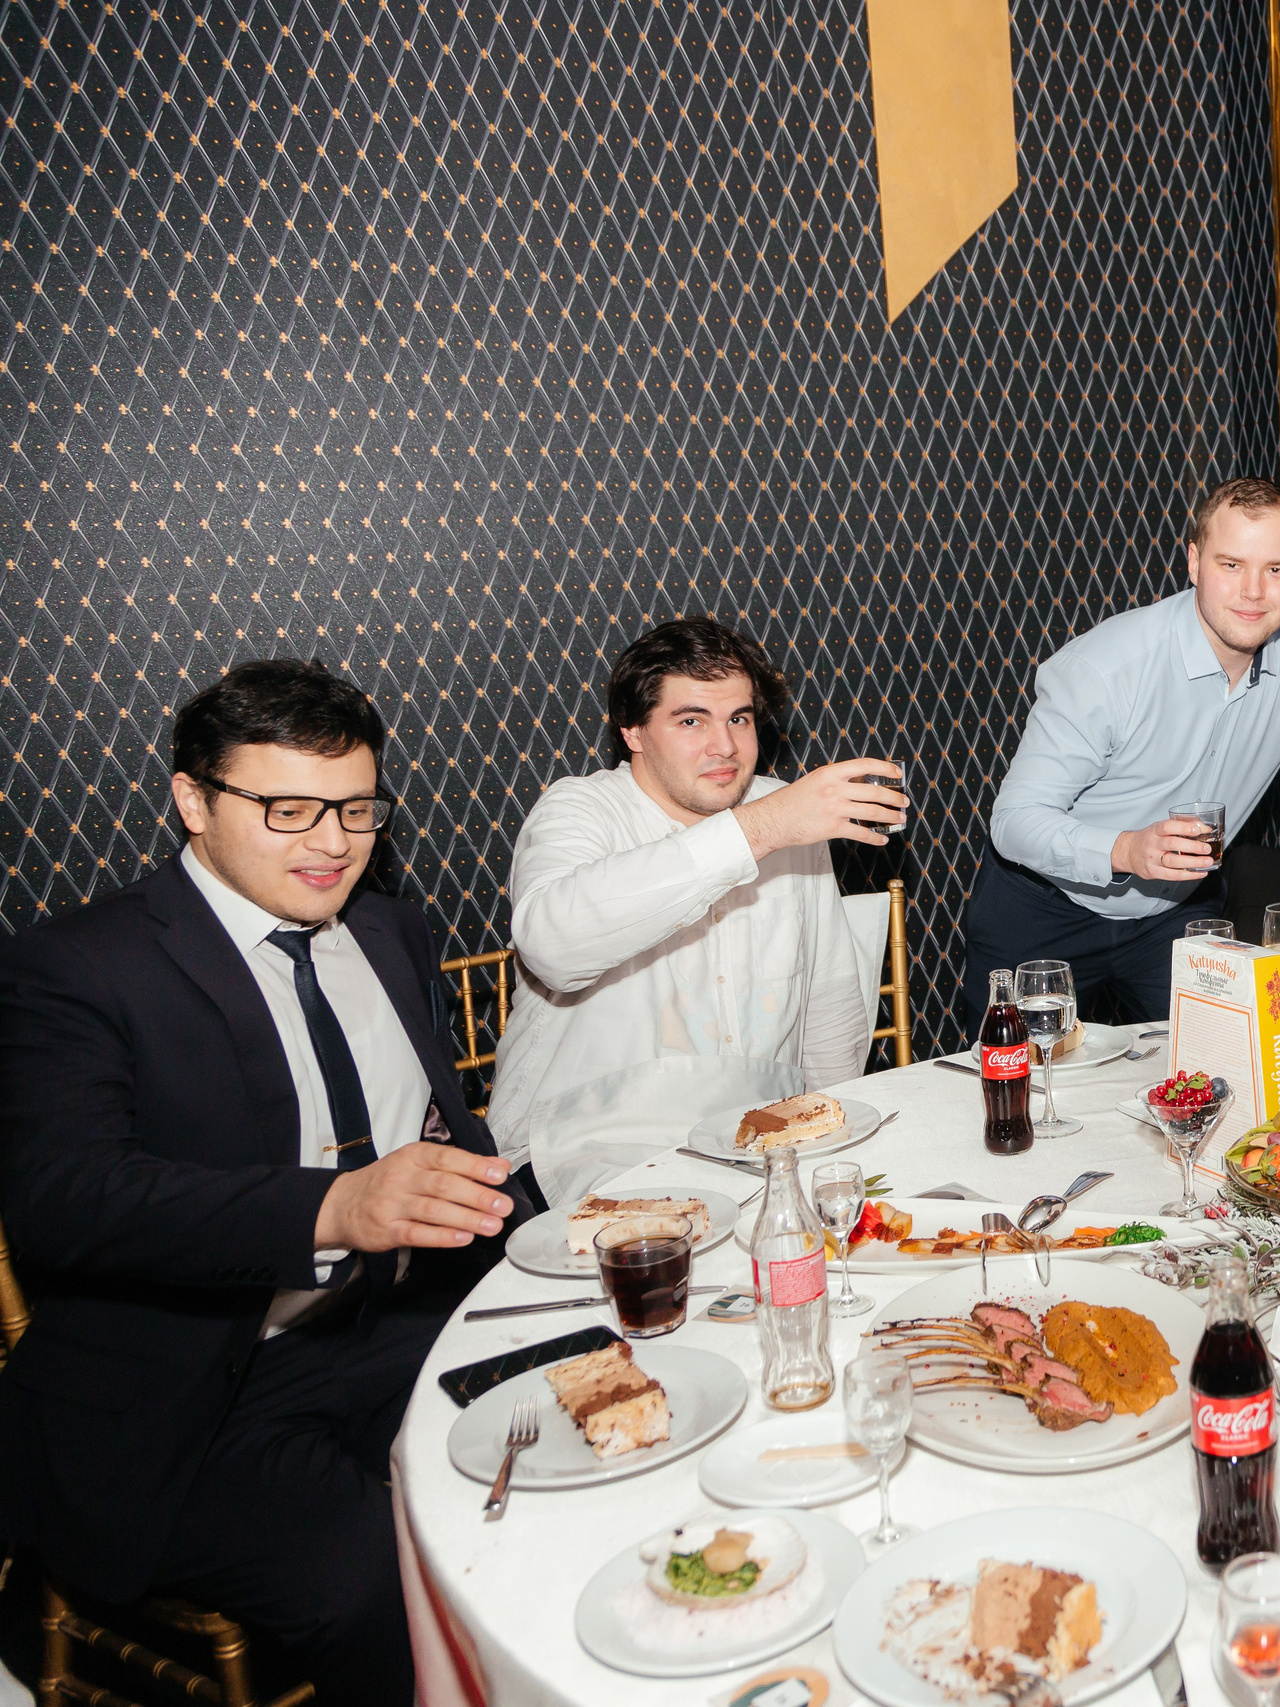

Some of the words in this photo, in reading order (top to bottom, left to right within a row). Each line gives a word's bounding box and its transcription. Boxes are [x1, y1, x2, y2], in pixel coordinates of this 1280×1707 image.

[1188, 953, 1237, 981] Katyusha
[988, 1046, 1029, 1067] Coca-Cola
[1197, 1398, 1271, 1435] Coca-Cola
